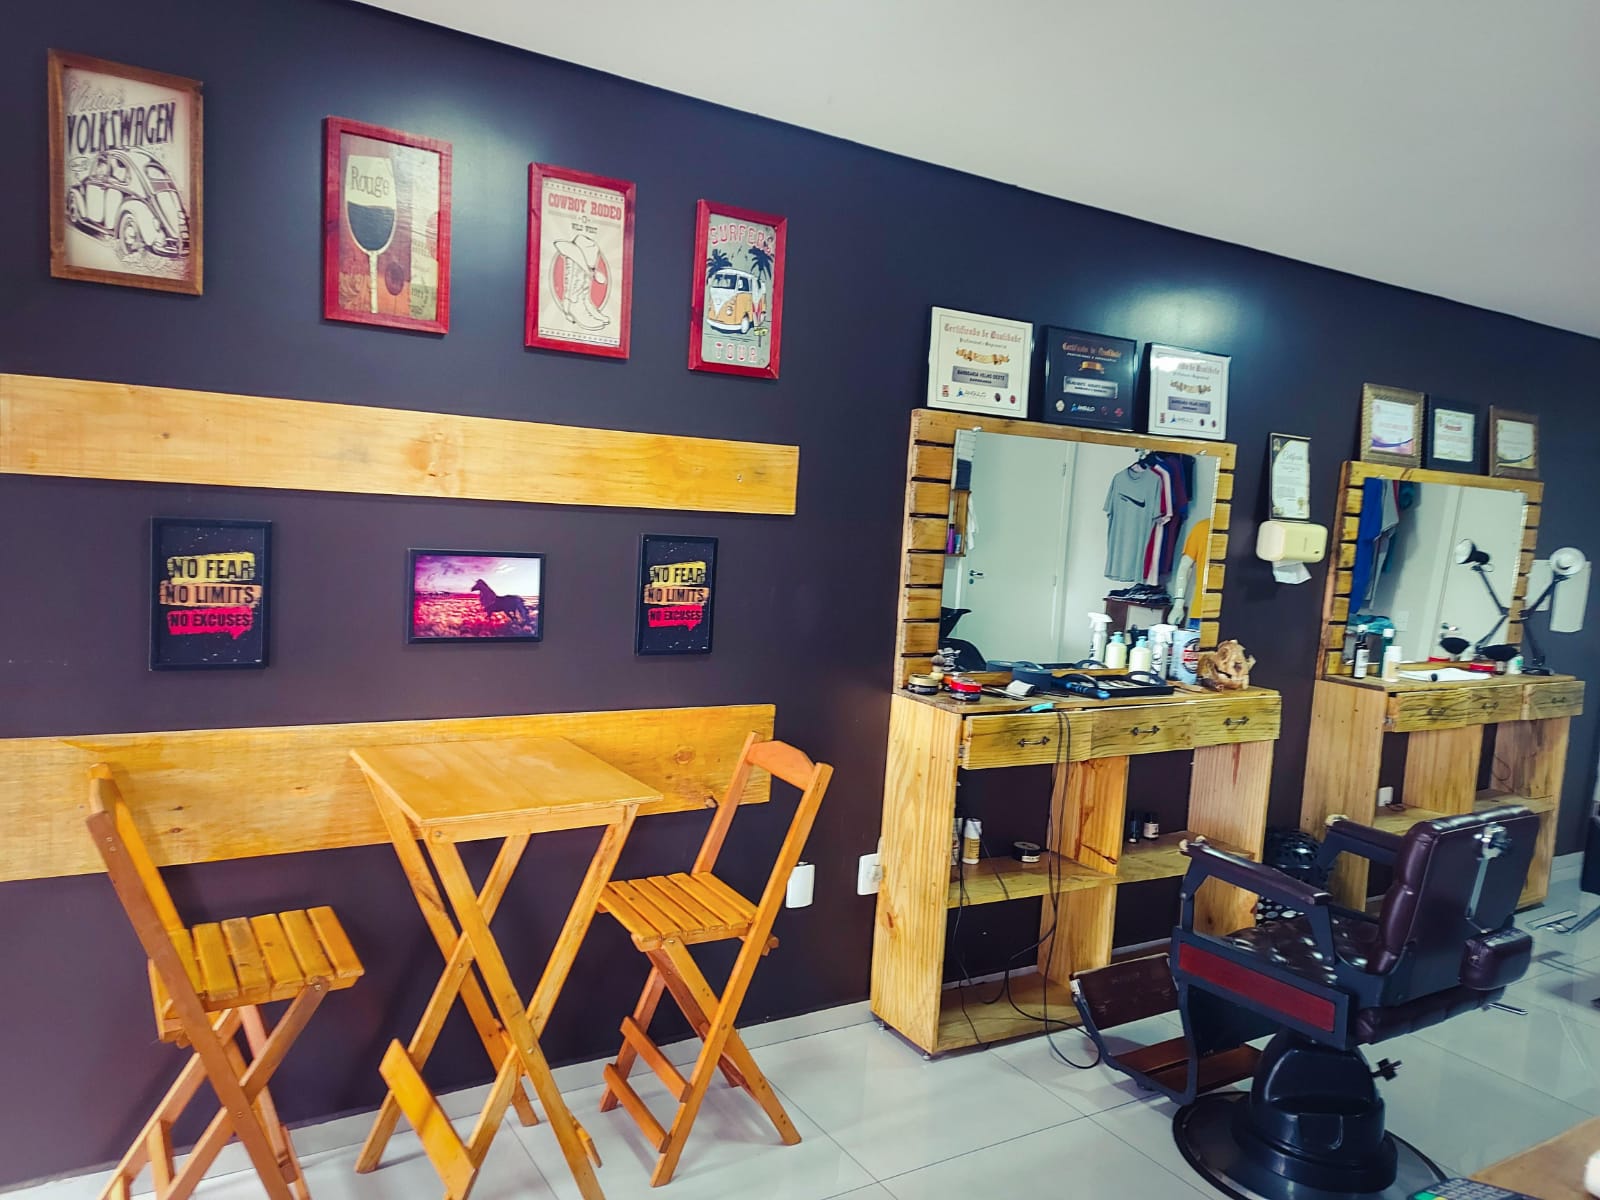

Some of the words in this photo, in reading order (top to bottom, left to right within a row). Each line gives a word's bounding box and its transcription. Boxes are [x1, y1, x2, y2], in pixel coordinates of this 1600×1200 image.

[67, 101, 176, 155] VOLKSWAGEN
[350, 165, 390, 198] Rouge
[547, 191, 588, 213] COWBOY
[590, 201, 622, 220] RODEO
[715, 341, 757, 362] TOUR
[170, 559, 198, 579] NO
[206, 559, 251, 579] FEAR
[652, 567, 669, 583] NO
[674, 567, 704, 583] FEAR
[165, 585, 189, 603] NO
[195, 585, 254, 604] LIMITS
[648, 588, 663, 602] NO
[666, 588, 704, 602] LIMITS
[169, 614, 189, 627] NO
[192, 613, 251, 627] EXCUSES
[650, 611, 662, 621] NO
[664, 610, 702, 621] EXCUSES
